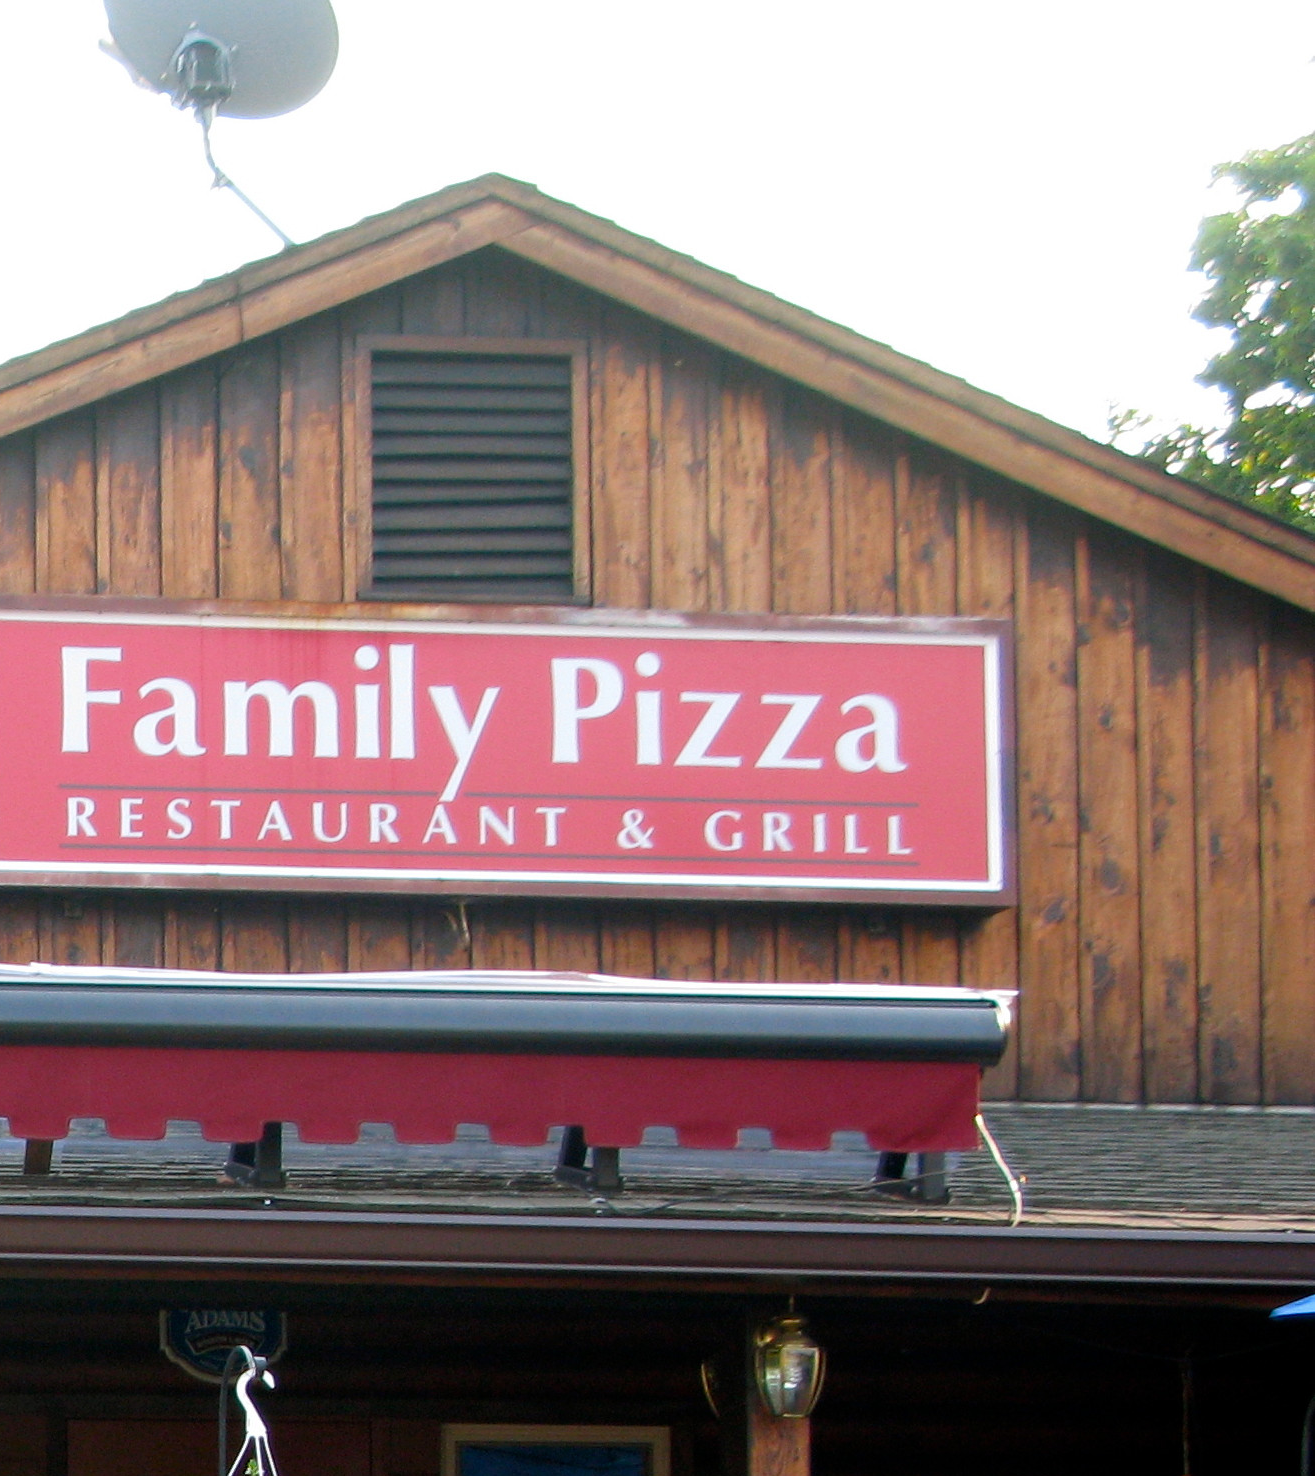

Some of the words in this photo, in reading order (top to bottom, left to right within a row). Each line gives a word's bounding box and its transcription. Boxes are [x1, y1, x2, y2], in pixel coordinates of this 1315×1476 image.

[61, 644, 500, 801] Family
[550, 651, 908, 774] Pizza
[67, 796, 568, 848] RESTAURANT
[616, 807, 654, 850] &
[704, 810, 913, 855] GRILL
[185, 1310, 266, 1333] ADAMS
